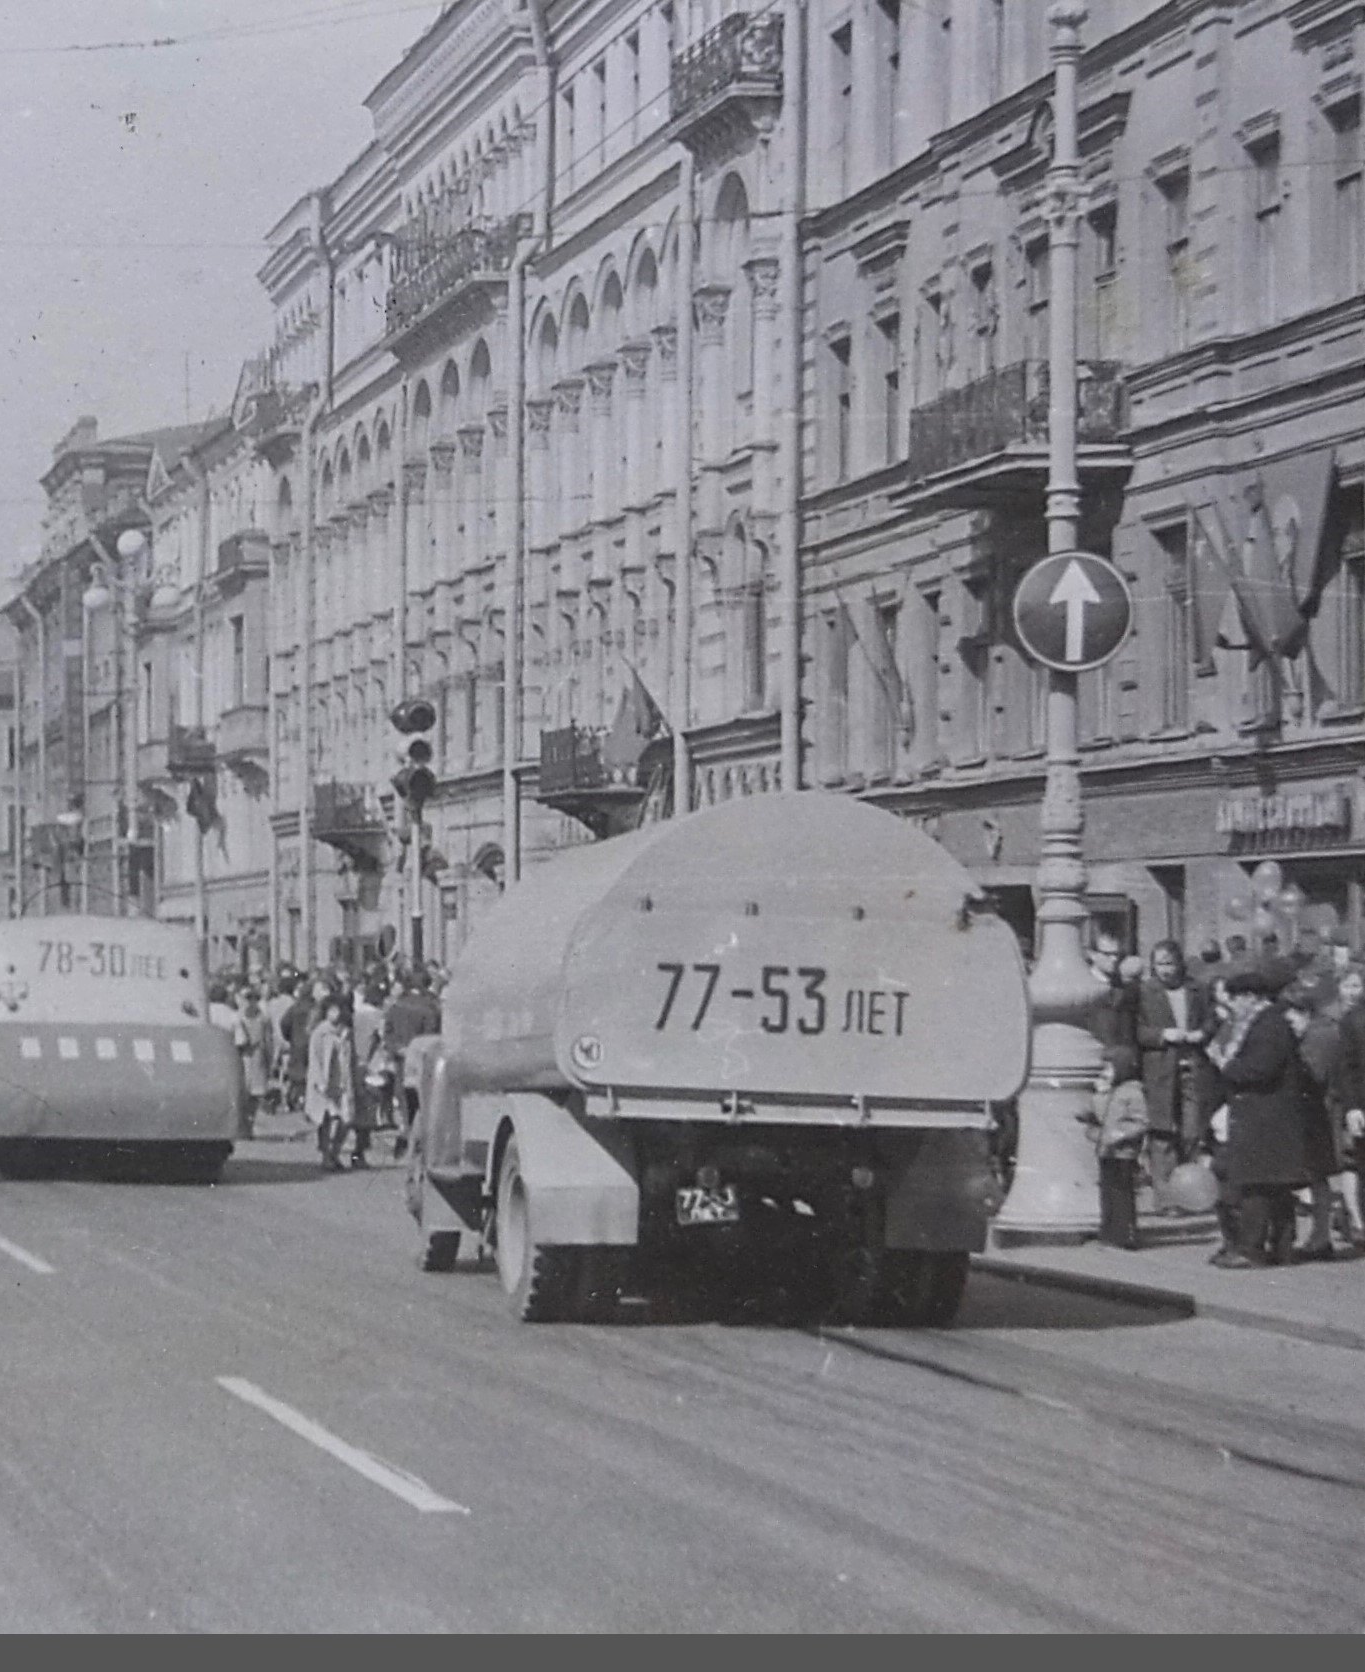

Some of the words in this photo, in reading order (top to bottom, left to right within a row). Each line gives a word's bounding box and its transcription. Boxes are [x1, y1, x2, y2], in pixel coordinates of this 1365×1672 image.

[38, 941, 125, 977] 78-30
[655, 962, 826, 1035] 77-53
[842, 989, 910, 1036] ЛЕТ
